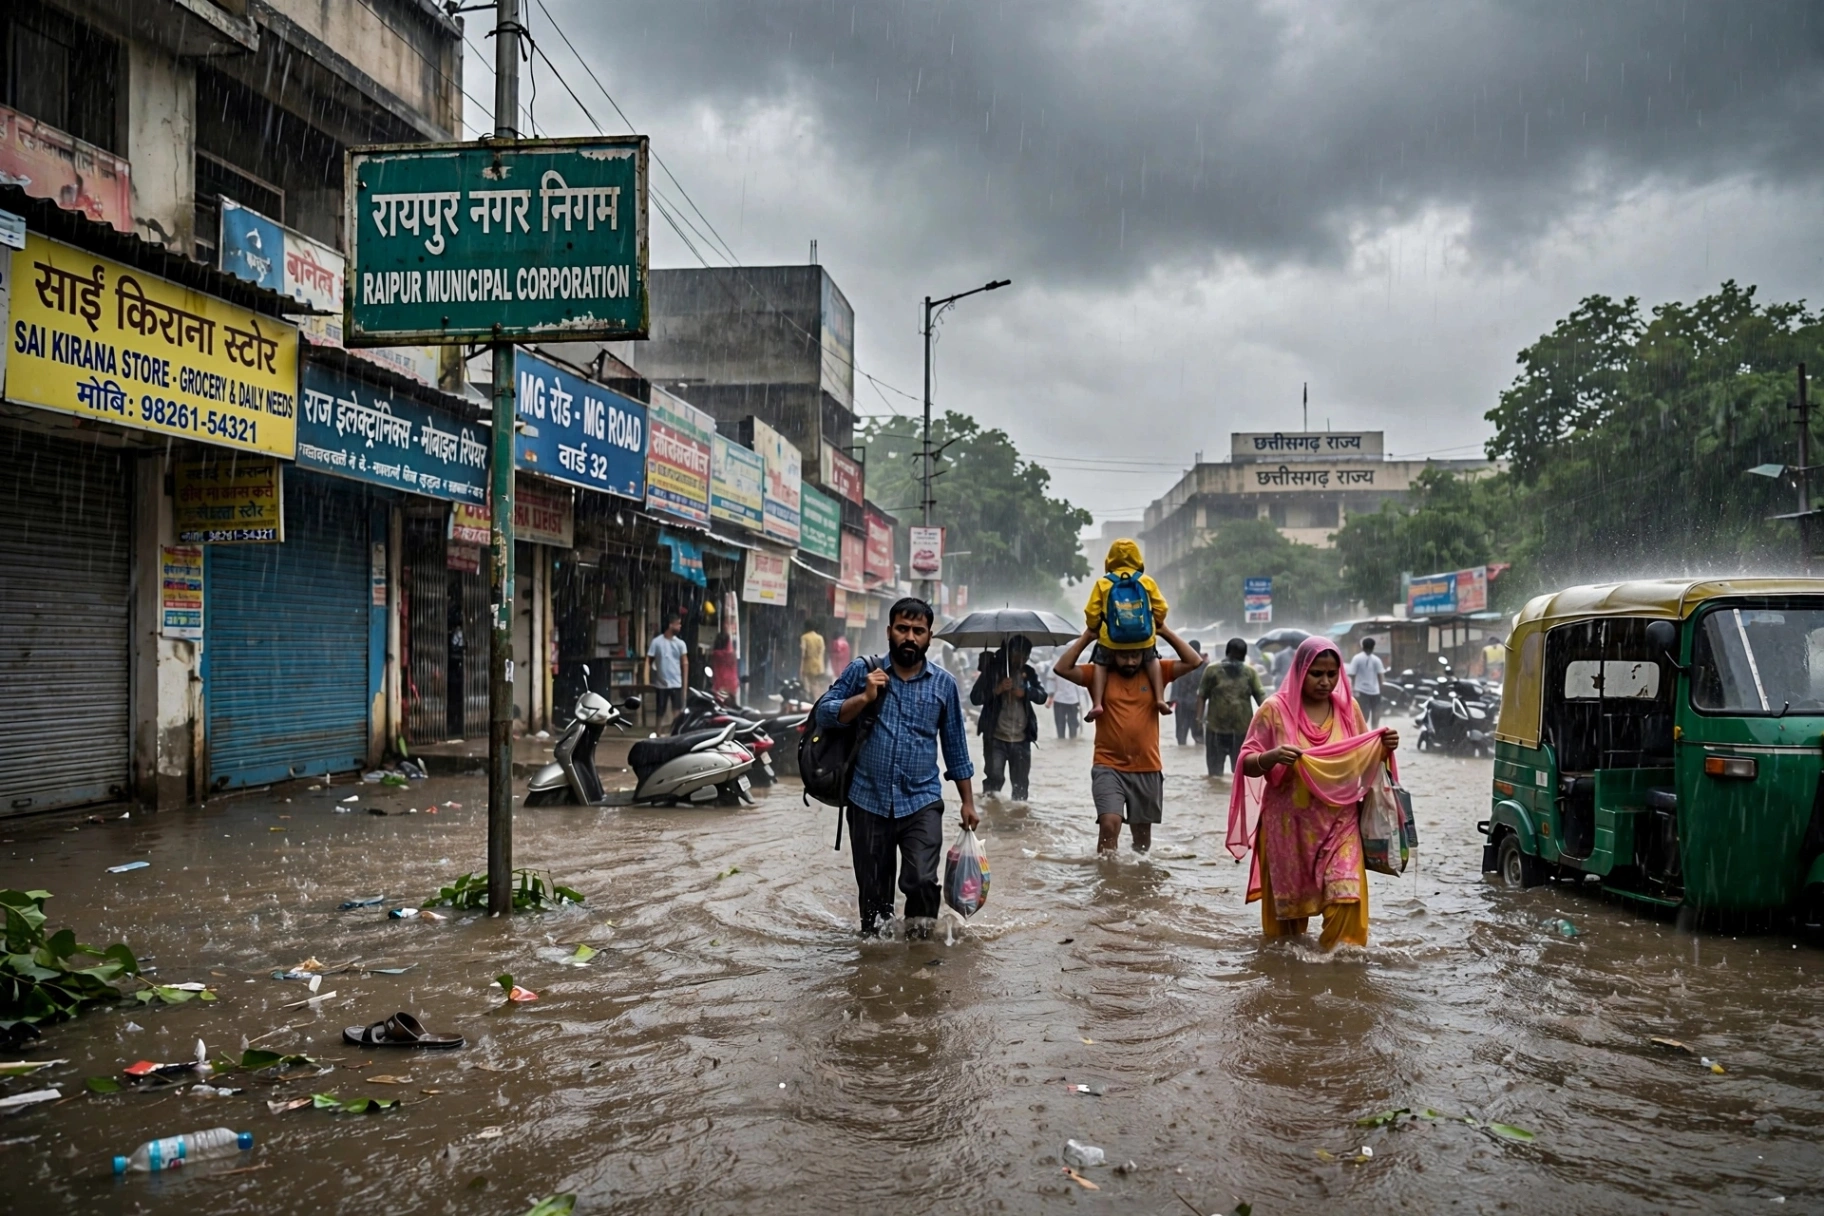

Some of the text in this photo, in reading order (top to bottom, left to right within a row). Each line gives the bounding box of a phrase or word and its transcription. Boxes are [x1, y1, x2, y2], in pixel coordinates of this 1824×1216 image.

[371, 169, 621, 255] रायपुर नगर निगम
[363, 264, 630, 305] RAIPUR MUNICIPAL CORPORATION
[115, 275, 216, 355] किराना
[224, 320, 278, 374] स्टोर
[15, 320, 46, 359] SAI
[52, 330, 117, 375] KIRANA
[122, 349, 170, 388] STORE
[180, 366, 227, 402] GROCERY
[229, 379, 236, 405] &
[239, 381, 264, 411] DAILY
[266, 390, 293, 419] NEEDS
[141, 395, 257, 444] 98261-54321
[304, 388, 334, 427] राज
[420, 416, 459, 465] मोबाइल
[459, 428, 488, 470] रिपेयर
[520, 371, 546, 419] MG
[550, 376, 573, 428] रोड
[584, 396, 605, 440] MG
[608, 406, 642, 452] ROAD
[1253, 432, 1362, 453] छत्तीसगढ़ राज्य
[558, 442, 608, 481] वार्ड 32
[1256, 465, 1375, 488] छत्तीसगढ़ राज्य
